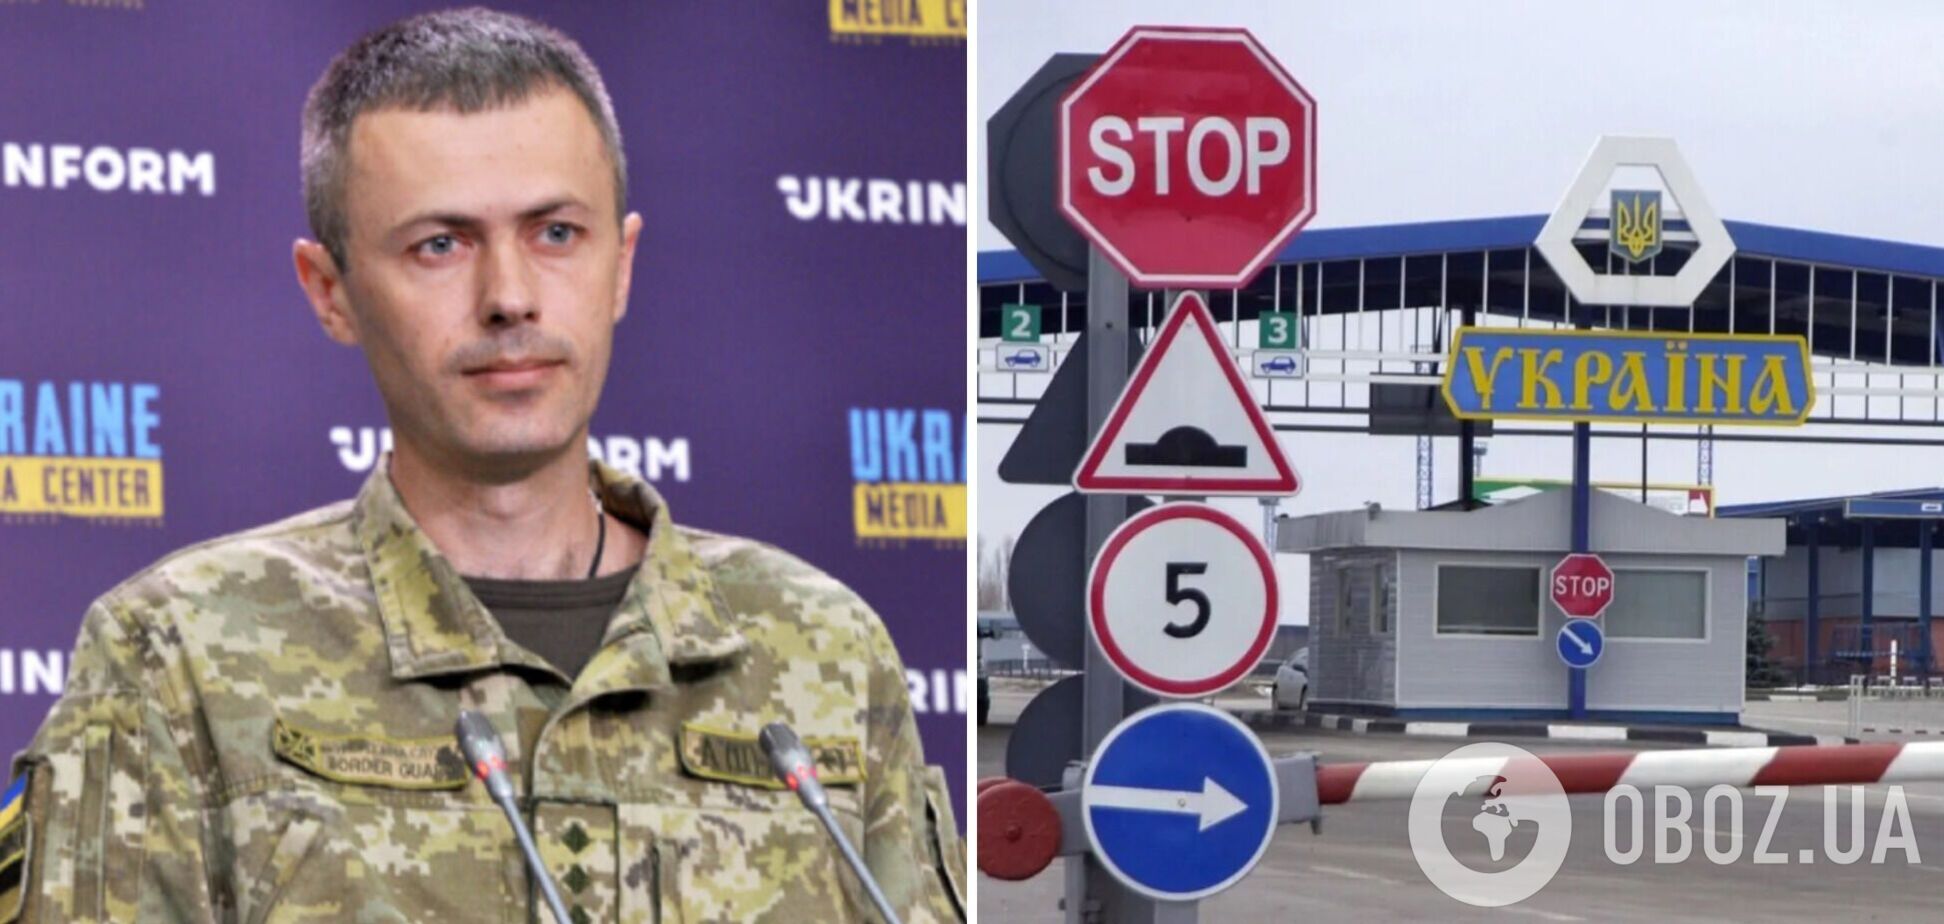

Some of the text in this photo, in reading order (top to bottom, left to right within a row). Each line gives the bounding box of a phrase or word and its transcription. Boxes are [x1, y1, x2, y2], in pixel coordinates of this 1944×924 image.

[3, 142, 216, 196] NFORM
[1087, 115, 1291, 197] STOP
[777, 175, 966, 226] UKRIN
[1011, 309, 1032, 338] 2
[1268, 317, 1288, 345] 3
[1463, 340, 1798, 416] УКРАЇНА
[0, 378, 161, 459] RAINE
[850, 407, 966, 483] UKR
[43, 466, 149, 507] CENTER
[866, 489, 947, 529] MEDIA
[1163, 562, 1211, 639] 5
[1555, 575, 1610, 597] STOP
[327, 755, 393, 777] BORDER
